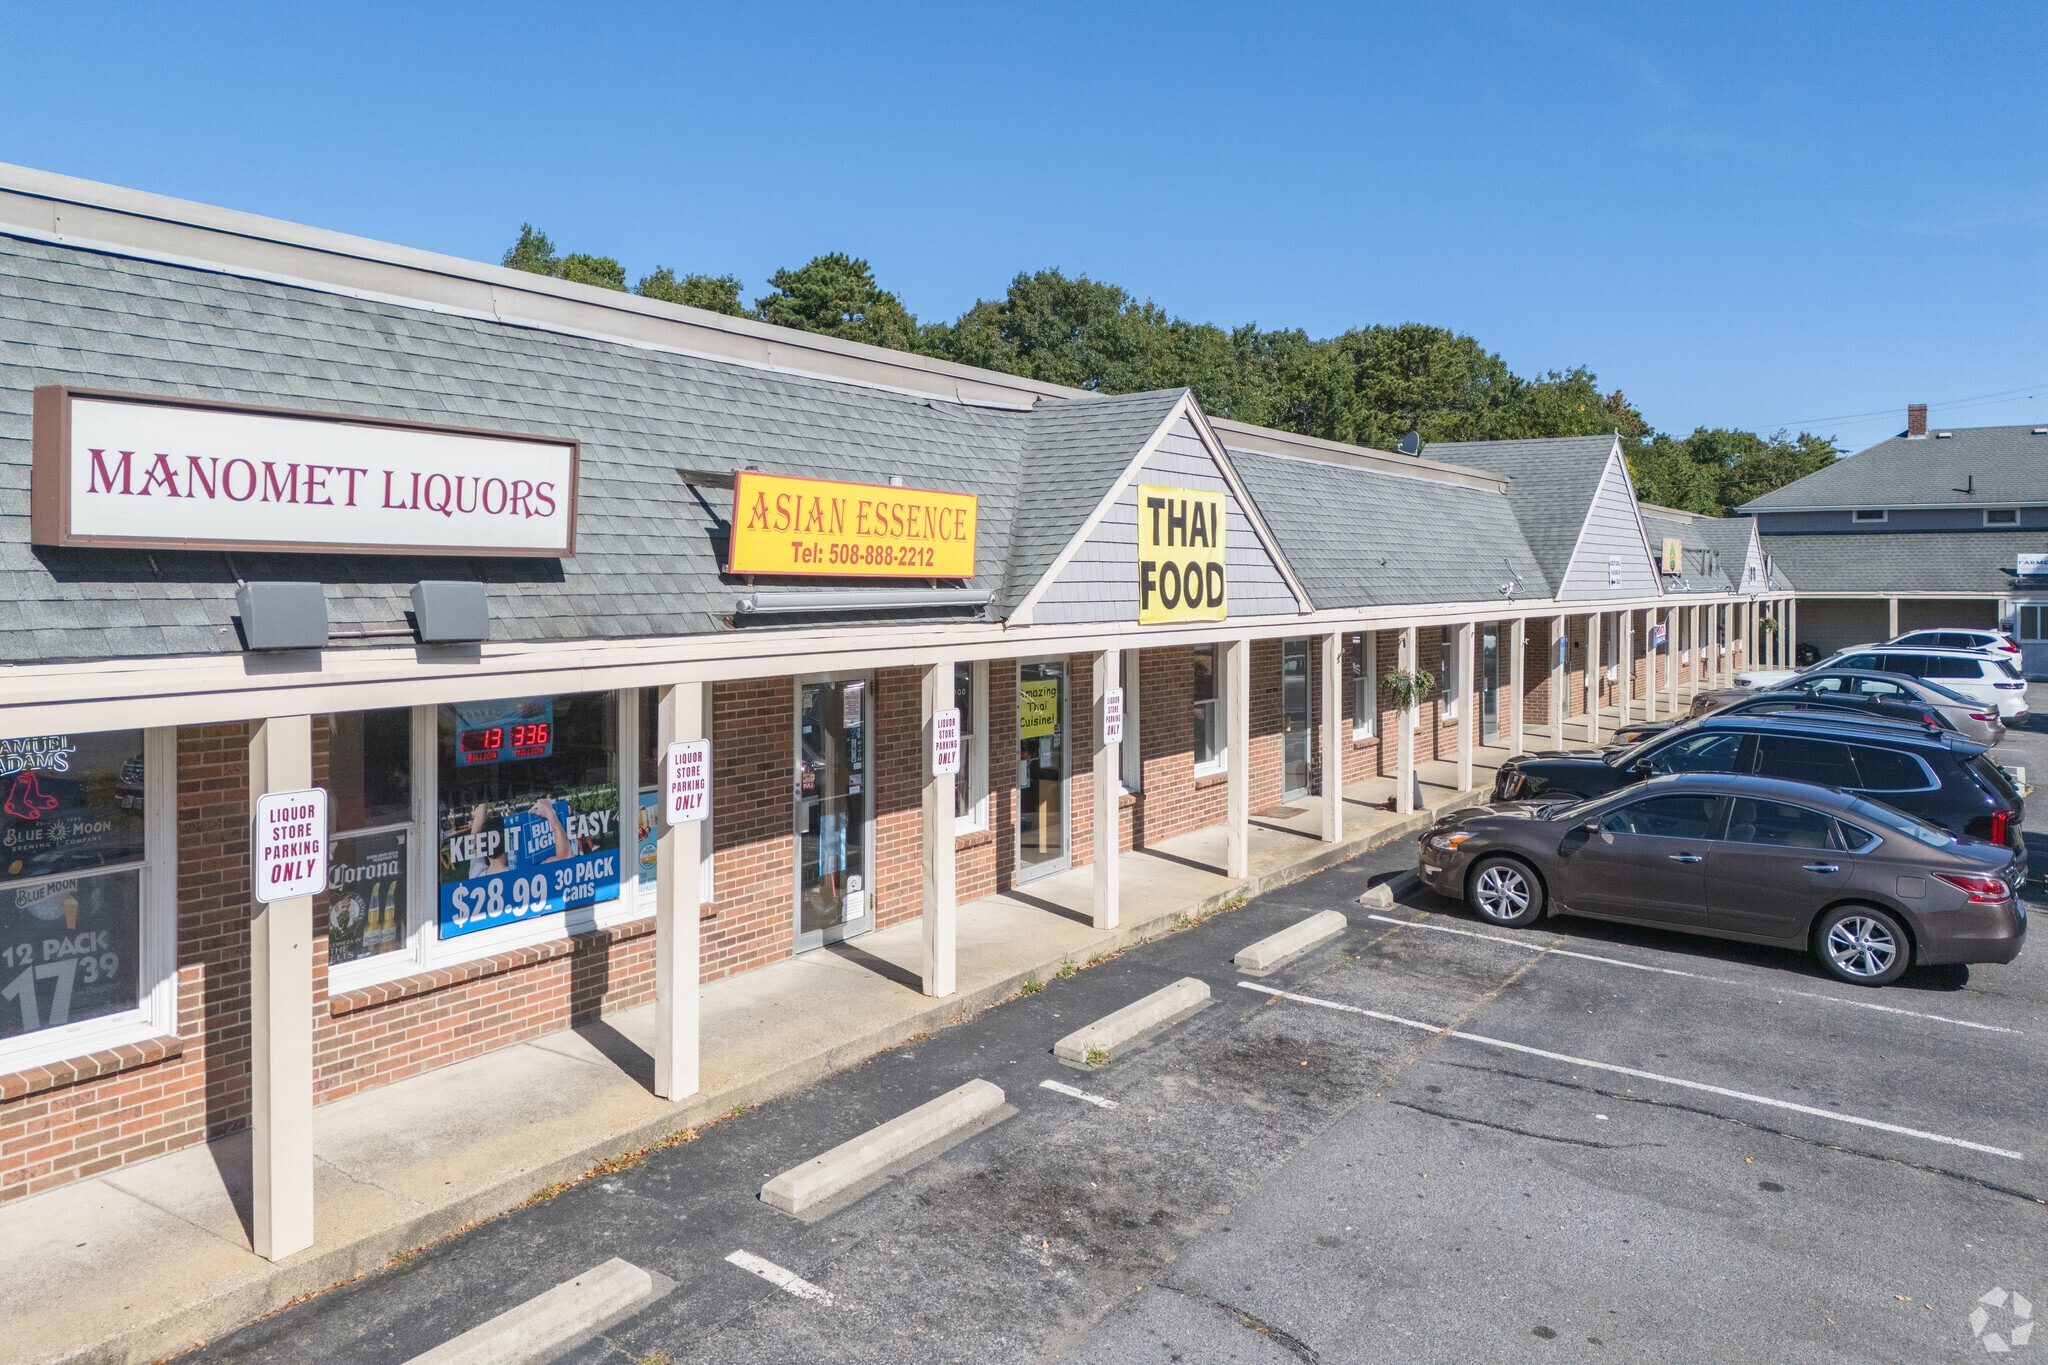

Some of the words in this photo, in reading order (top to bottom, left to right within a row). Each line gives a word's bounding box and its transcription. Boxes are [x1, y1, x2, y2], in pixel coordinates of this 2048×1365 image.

[87, 449, 368, 507] MANOMET
[381, 470, 557, 519] LIQUORS
[747, 492, 846, 534] ASIAN
[856, 500, 967, 541] ESSENCE
[1147, 497, 1217, 548] THAI
[791, 541, 823, 563] Tel:
[829, 543, 934, 567] 508-888-2212
[1141, 561, 1224, 610] FOOD
[1027, 701, 1047, 712] Thai
[937, 718, 955, 728] LIQUOR
[1020, 715, 1055, 728] Cuisine!
[514, 723, 548, 746] 336
[939, 729, 954, 739] STORE
[0, 736, 75, 756] AMUEL
[936, 740, 957, 751] PARKING
[675, 751, 703, 765] LIQUOR
[938, 751, 956, 765] ONLY
[676, 765, 700, 779] STORE
[672, 779, 705, 793] PARKING
[675, 793, 703, 811] ONLY
[270, 805, 315, 823] LIQUOR
[3, 828, 43, 846] BLUE
[73, 821, 111, 835] MOON
[273, 823, 311, 841] STORE
[450, 830, 500, 864] KEEP
[504, 826, 521, 852] IT
[566, 810, 611, 840] EASY
[532, 820, 553, 838] BU
[265, 840, 319, 861] PARKING
[527, 832, 556, 854] LIGH
[271, 858, 316, 884] ONLY
[328, 860, 399, 891] Corona
[554, 868, 572, 891] 30
[575, 856, 614, 883] PACK
[16, 888, 45, 907] BLUE
[47, 879, 76, 894] MOON
[452, 873, 548, 928] $28.99
[562, 882, 595, 903] cans
[2, 943, 33, 968] 12
[43, 930, 110, 960] PACK
[330, 951, 354, 963] ELTS
